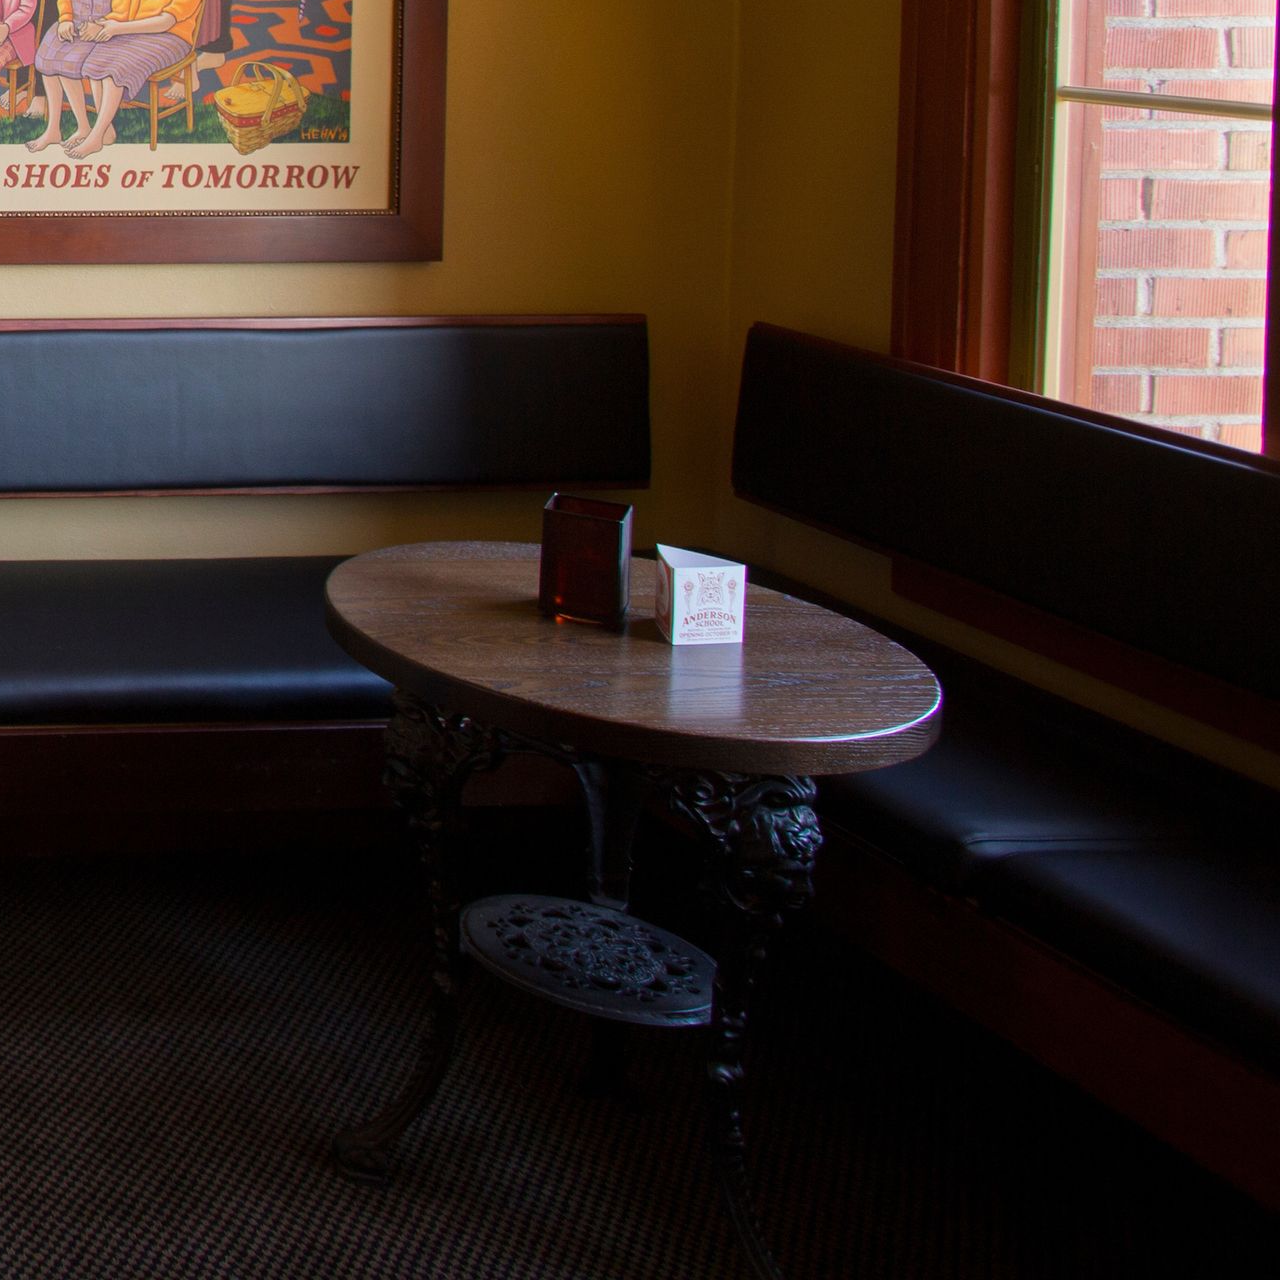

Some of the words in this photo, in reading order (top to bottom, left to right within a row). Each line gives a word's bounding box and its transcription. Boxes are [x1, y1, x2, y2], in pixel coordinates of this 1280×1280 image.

[3, 163, 112, 188] SHOES
[120, 170, 154, 188] OF
[161, 164, 360, 189] TOMORROW
[683, 611, 736, 626] ANDERSON
